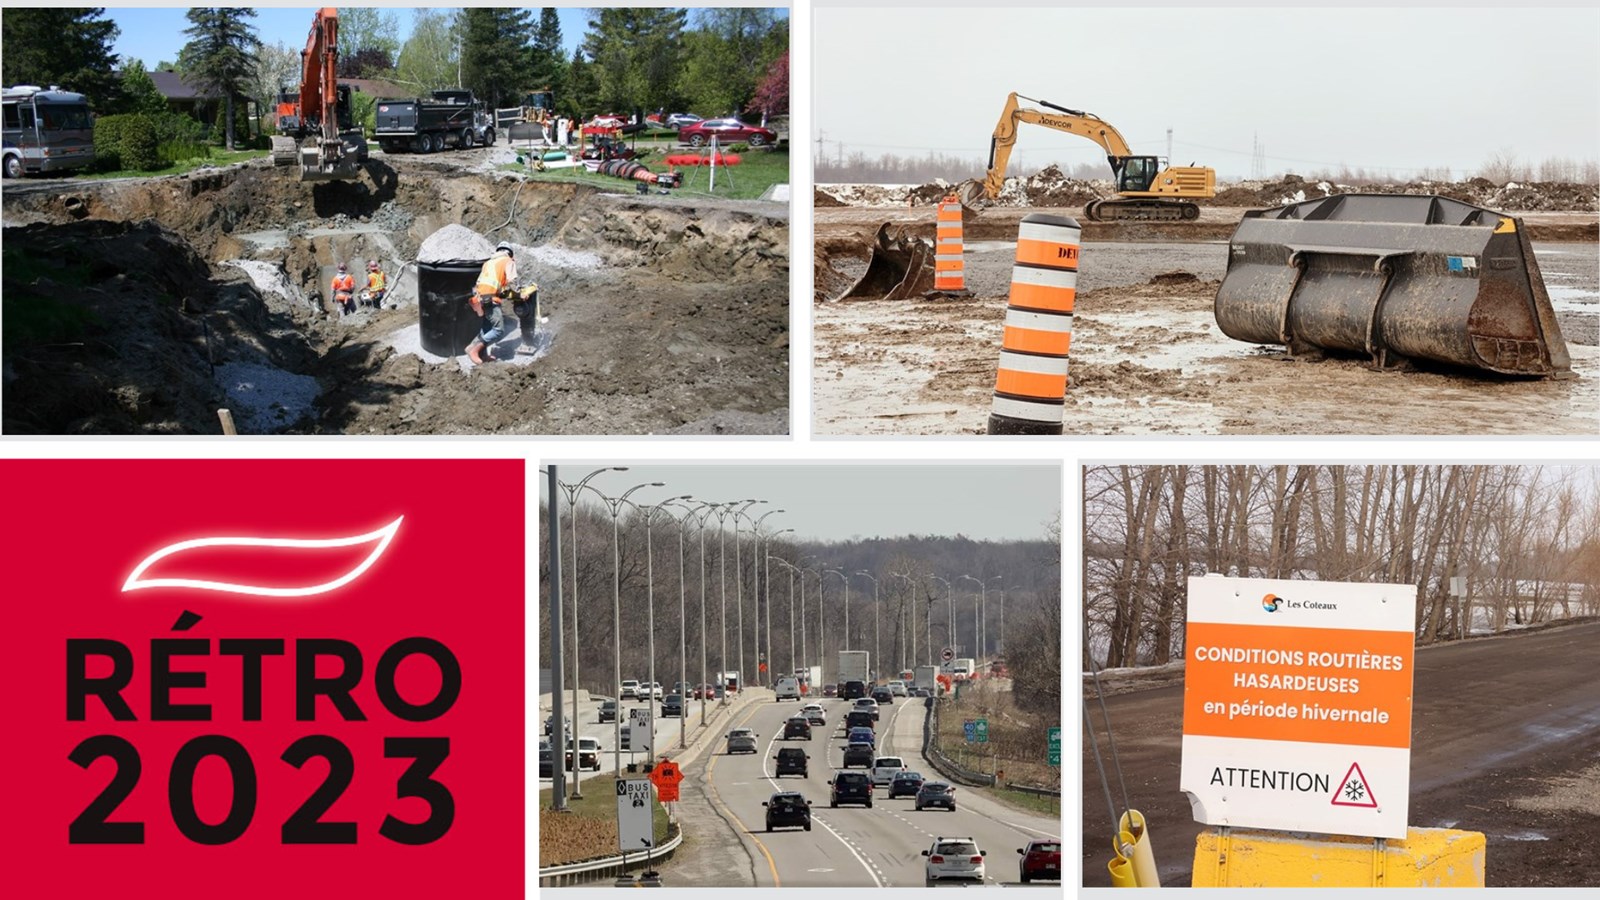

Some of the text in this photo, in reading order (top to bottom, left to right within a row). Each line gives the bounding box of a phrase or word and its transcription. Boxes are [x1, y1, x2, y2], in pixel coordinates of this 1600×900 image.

[1045, 118, 1072, 129] DEVCOR
[1287, 600, 1337, 610] Les Coteaux
[1195, 647, 1403, 671] CONDITIONS ROUTIÈRES
[1233, 673, 1359, 694] HASARDEUSES
[1204, 699, 1389, 724] en période hivernale
[628, 783, 648, 791] BUS
[1210, 767, 1330, 793] ATTENTION
[628, 791, 649, 800] TAXI
